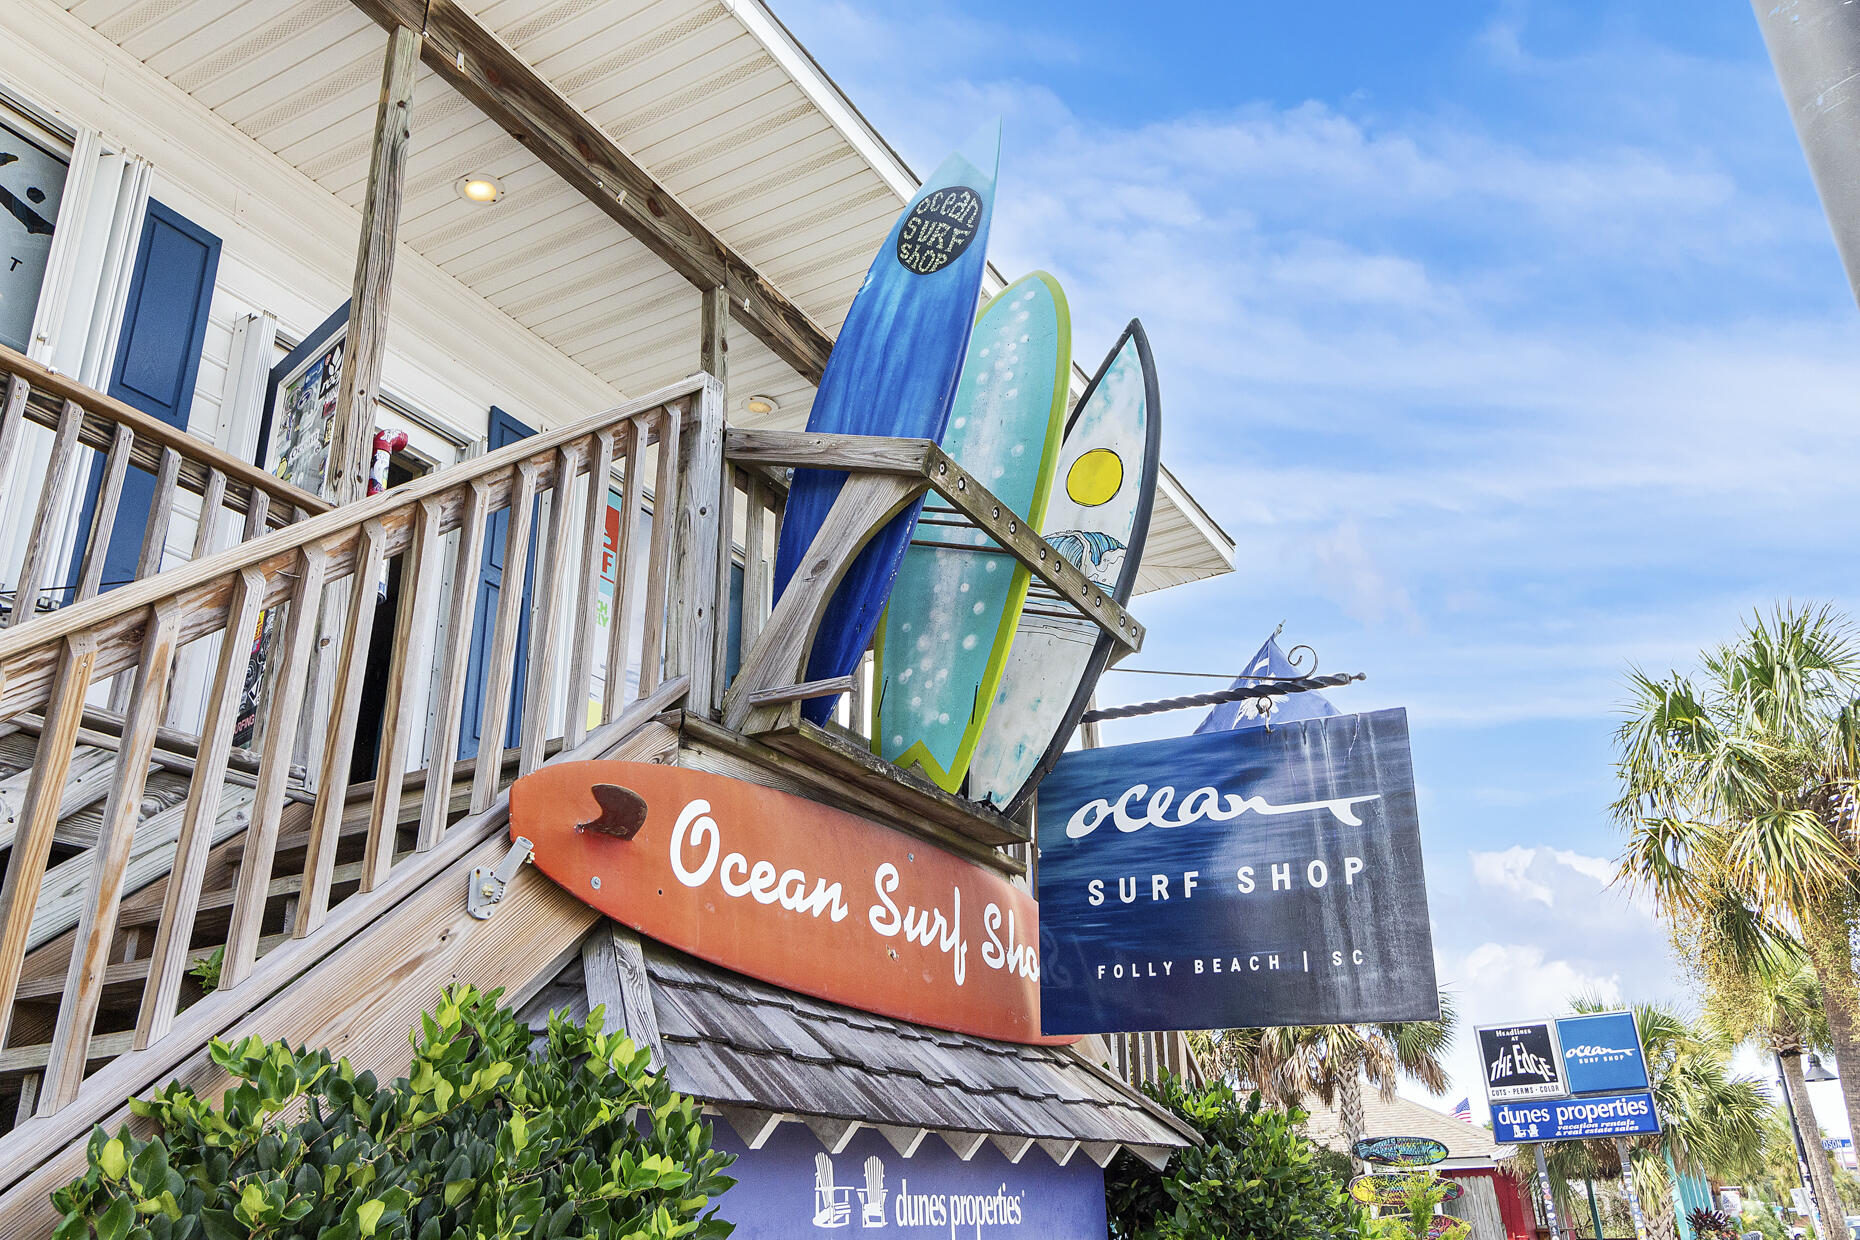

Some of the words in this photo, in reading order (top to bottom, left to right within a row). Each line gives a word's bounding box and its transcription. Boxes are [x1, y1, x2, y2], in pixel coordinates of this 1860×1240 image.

[903, 216, 971, 252] SURF
[234, 714, 255, 734] URFING
[1066, 784, 1381, 838] ocean
[669, 799, 848, 923] Ocean
[869, 863, 968, 986] Surf
[981, 903, 1040, 983] Sho
[1088, 871, 1199, 906] SURF
[1237, 857, 1364, 894] SHOP
[1098, 961, 1173, 979] FOLLY
[1194, 954, 1280, 974] BEACH
[1332, 949, 1364, 967] SC
[1490, 1046, 1513, 1082] THE
[1512, 1041, 1556, 1082] EDGE
[1565, 1045, 1635, 1059] ocean
[1603, 1054, 1624, 1062] SHOP
[1491, 1089, 1507, 1097] CUTS
[1512, 1086, 1534, 1095] PERMS
[1539, 1084, 1560, 1093] COLOR
[1498, 1106, 1550, 1125] dunes
[1556, 1097, 1648, 1125] properties
[1557, 1122, 1598, 1131] vacation
[1600, 1118, 1635, 1127] rentals
[1563, 1127, 1582, 1136] real
[1585, 1125, 1613, 1134] estate
[1615, 1123, 1639, 1131] sales
[1823, 1139, 1842, 1149] DSON
[895, 1178, 947, 1227] dunes
[950, 1182, 1022, 1240] properties
